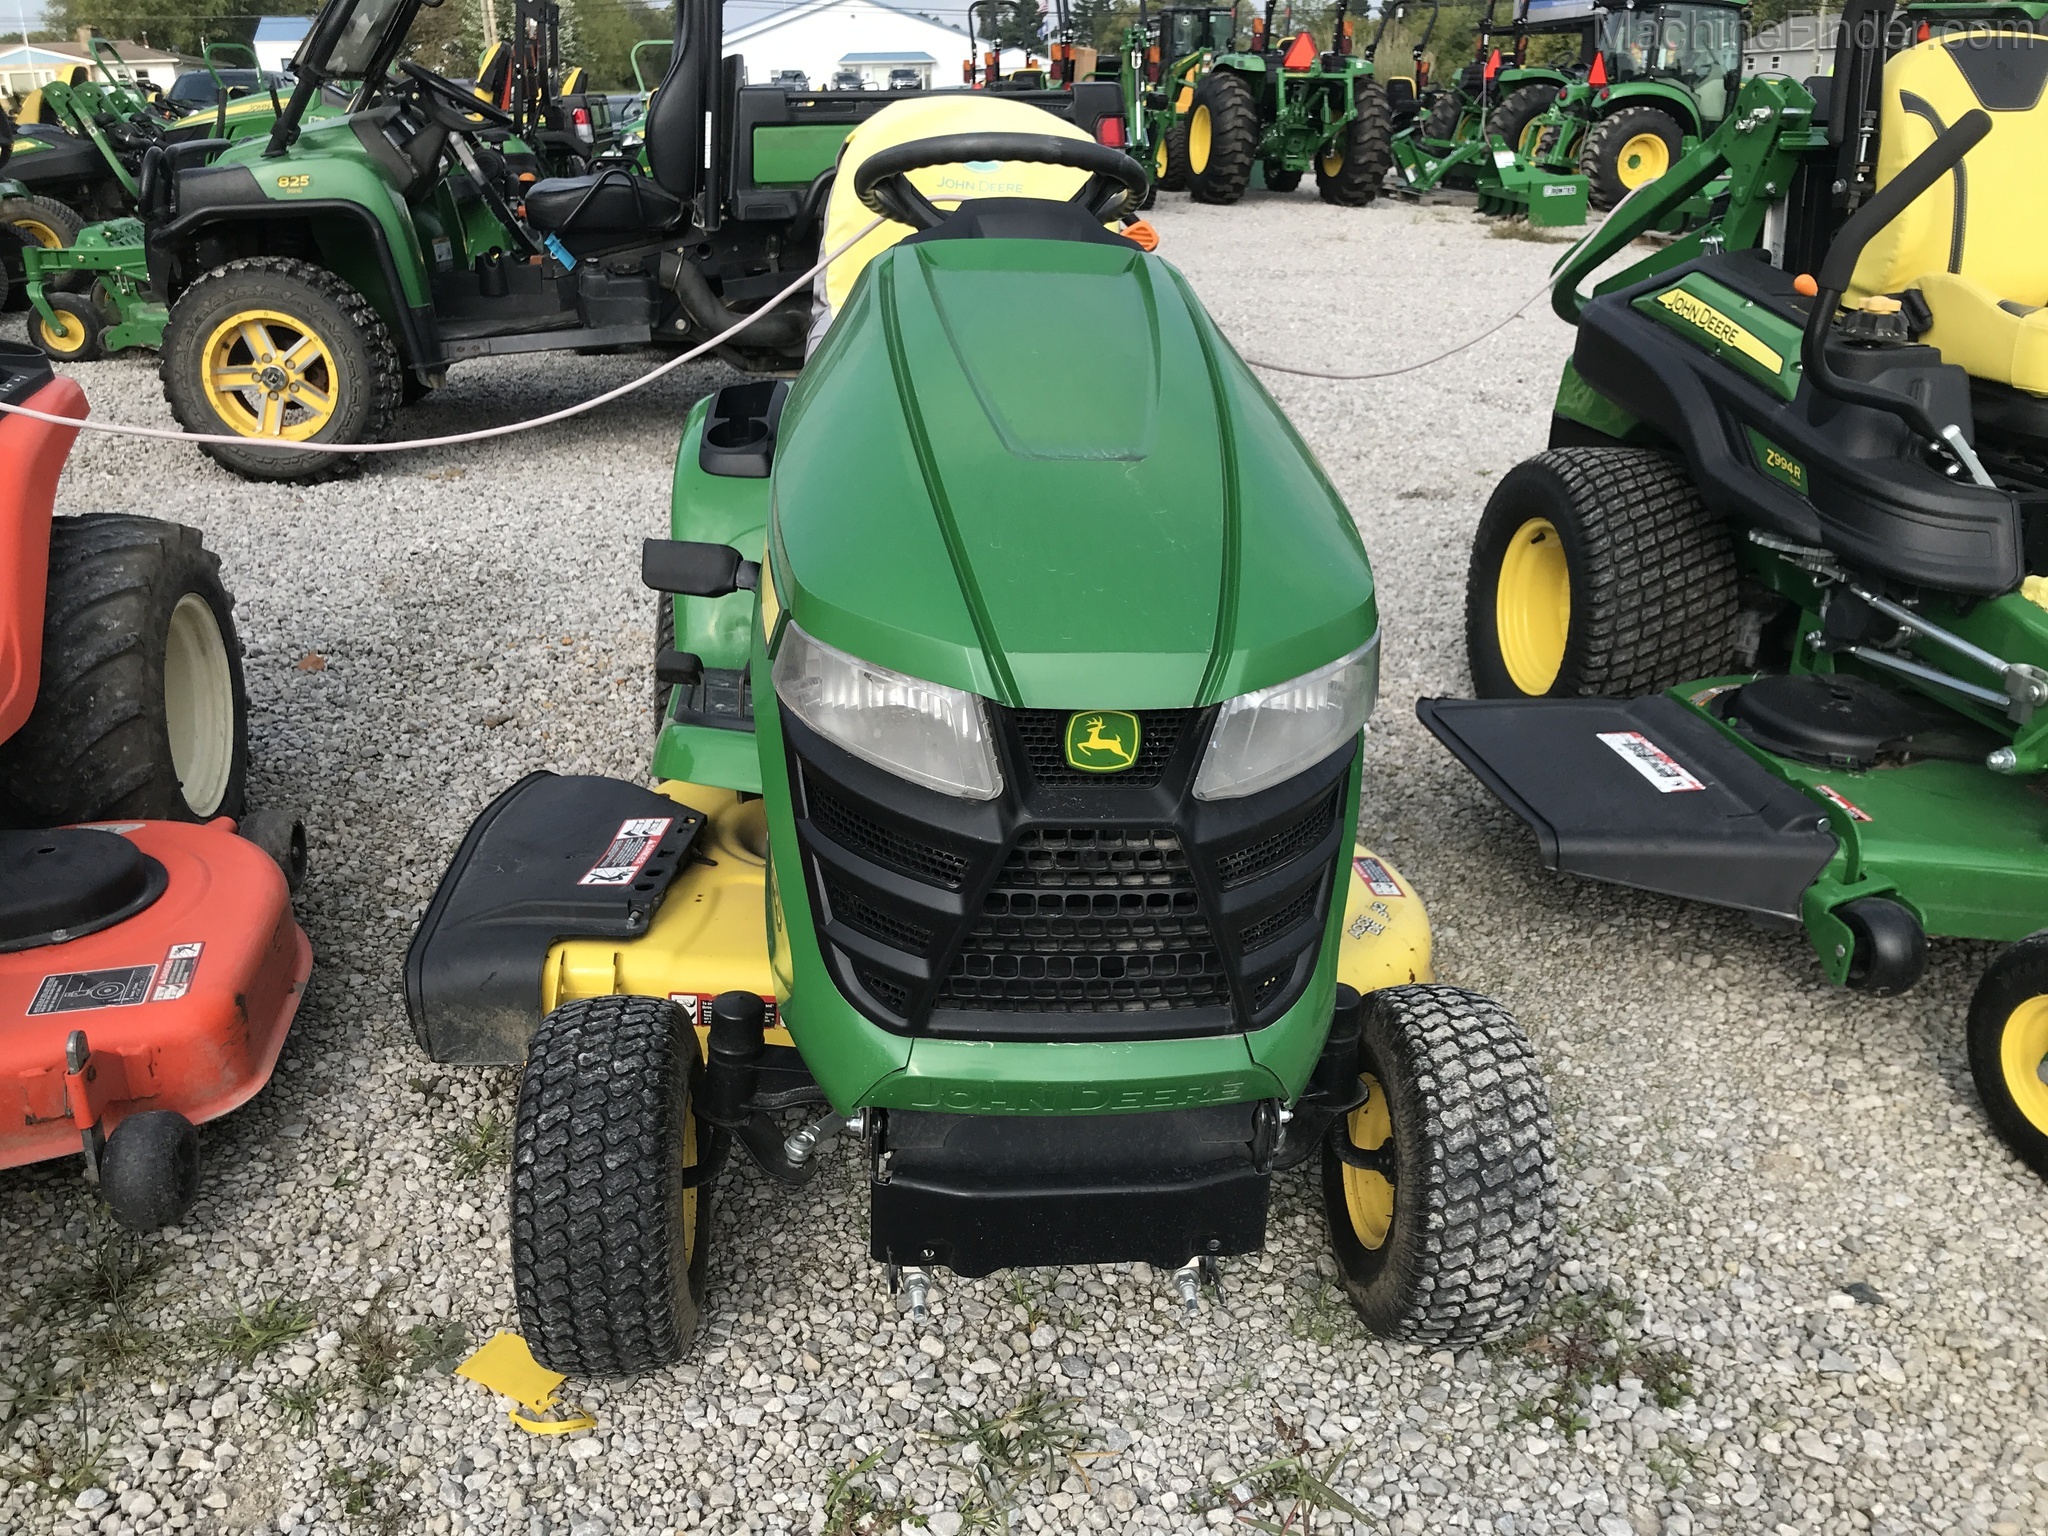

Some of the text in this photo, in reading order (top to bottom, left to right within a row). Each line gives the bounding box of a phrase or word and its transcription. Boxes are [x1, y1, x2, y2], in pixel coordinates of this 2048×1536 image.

[278, 175, 310, 188] 825
[937, 177, 1024, 193] JOHN DEERE
[1668, 292, 1740, 344] JOHN DEERE
[1766, 448, 1801, 479] Z994R
[912, 1082, 1244, 1111] JOHN DEERE
